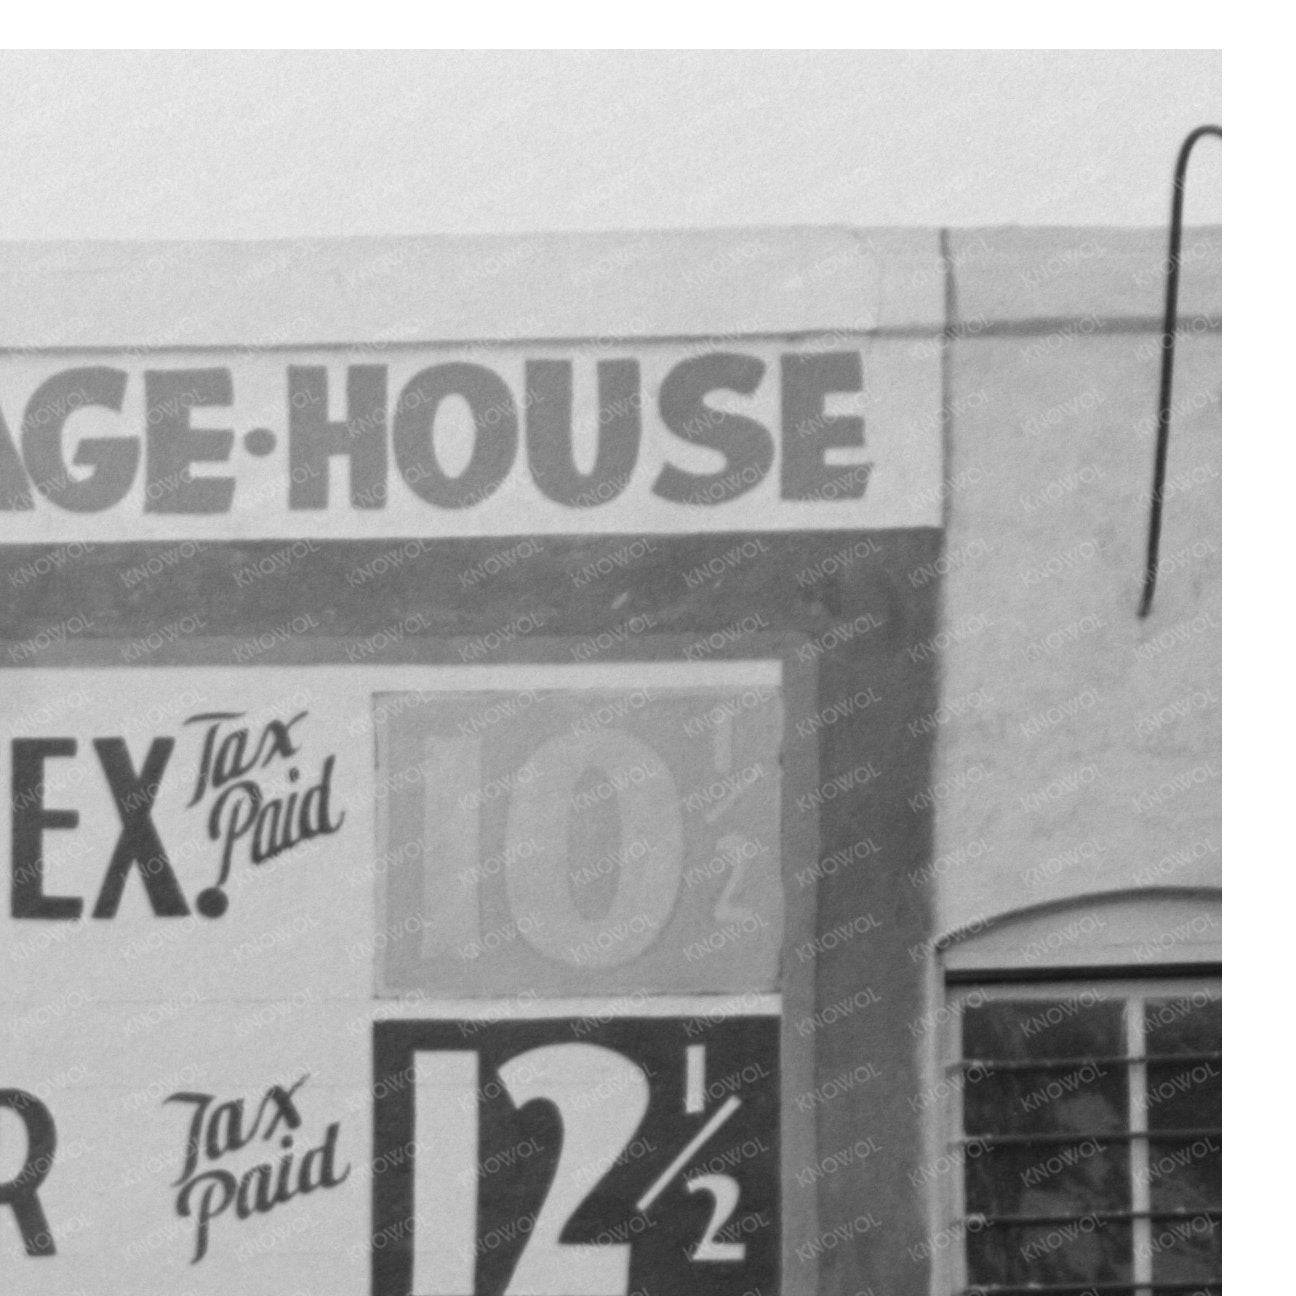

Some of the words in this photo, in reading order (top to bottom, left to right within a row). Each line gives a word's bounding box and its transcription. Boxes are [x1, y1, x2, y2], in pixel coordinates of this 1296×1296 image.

[287, 351, 874, 511] HOUSE
[183, 710, 309, 810] Tax
[208, 753, 346, 886] Paid
[162, 1073, 310, 1188] Tax
[176, 1120, 351, 1266] Paid
